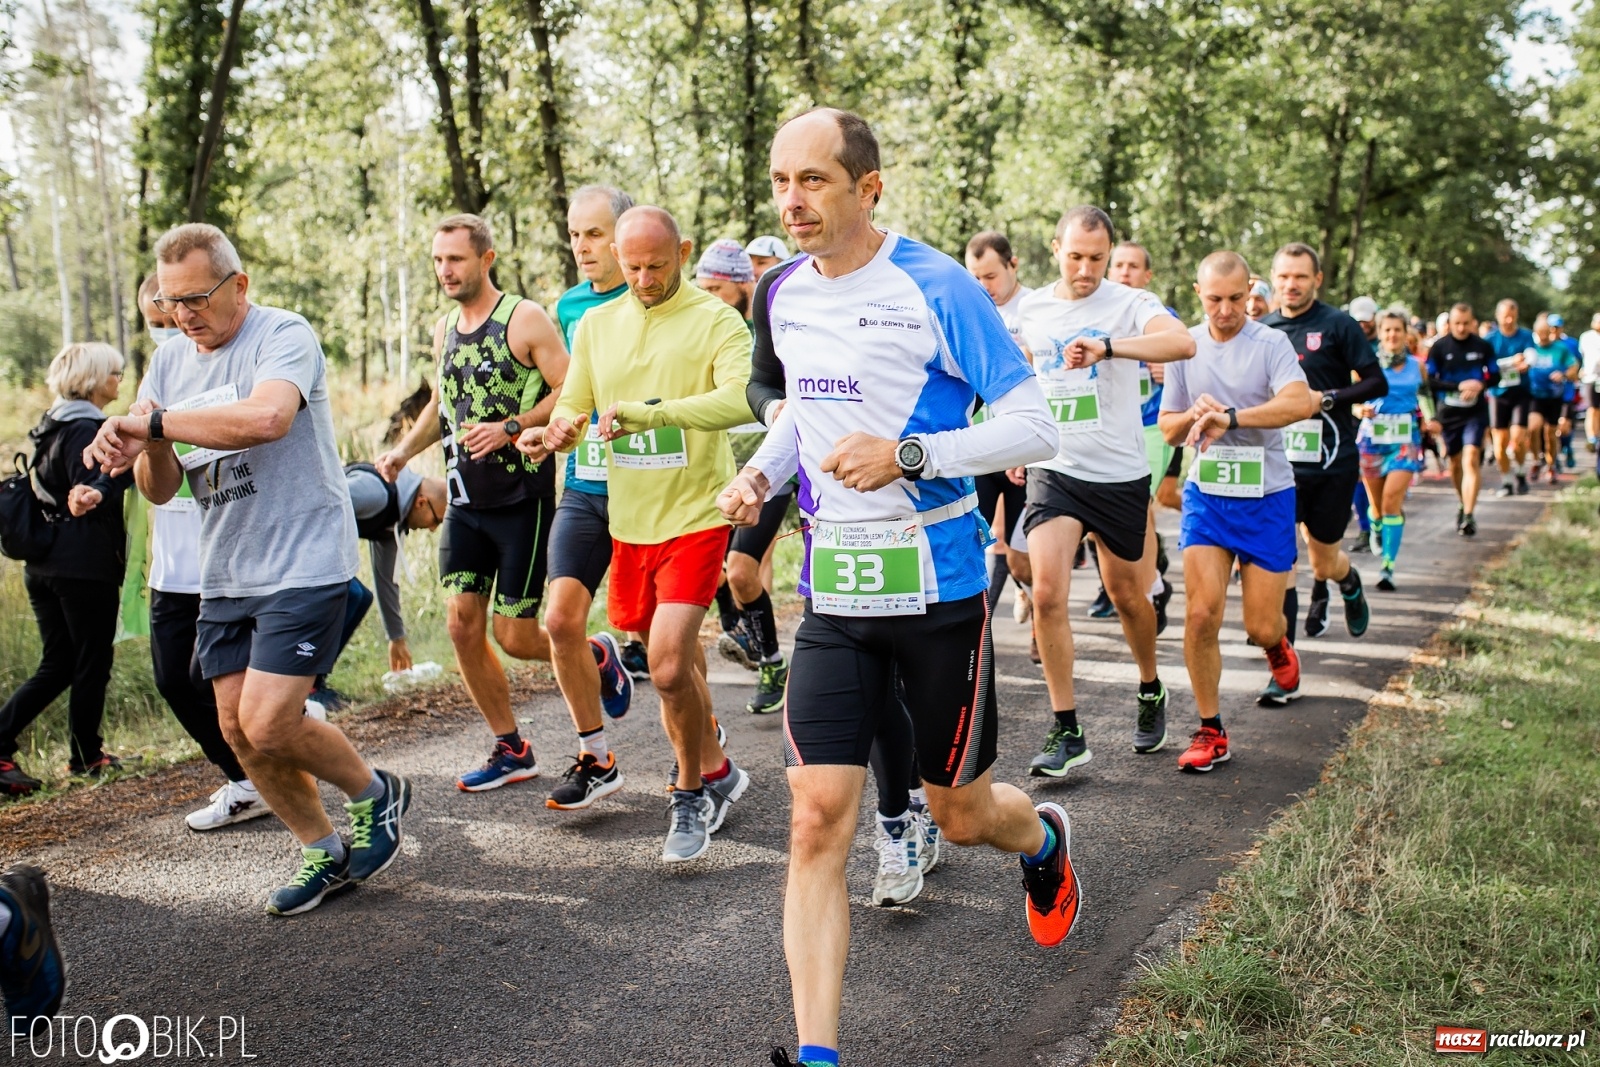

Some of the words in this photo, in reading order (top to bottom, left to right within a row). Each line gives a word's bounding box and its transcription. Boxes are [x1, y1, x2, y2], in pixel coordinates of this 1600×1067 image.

[859, 318, 878, 327] ALGO
[881, 320, 904, 328] SERWIS
[798, 375, 863, 395] marek
[1050, 399, 1077, 421] 77
[628, 428, 657, 454] 41
[231, 463, 252, 480] THE
[1216, 462, 1241, 484] 31
[212, 480, 258, 507] MACHINE
[834, 553, 885, 592] 33
